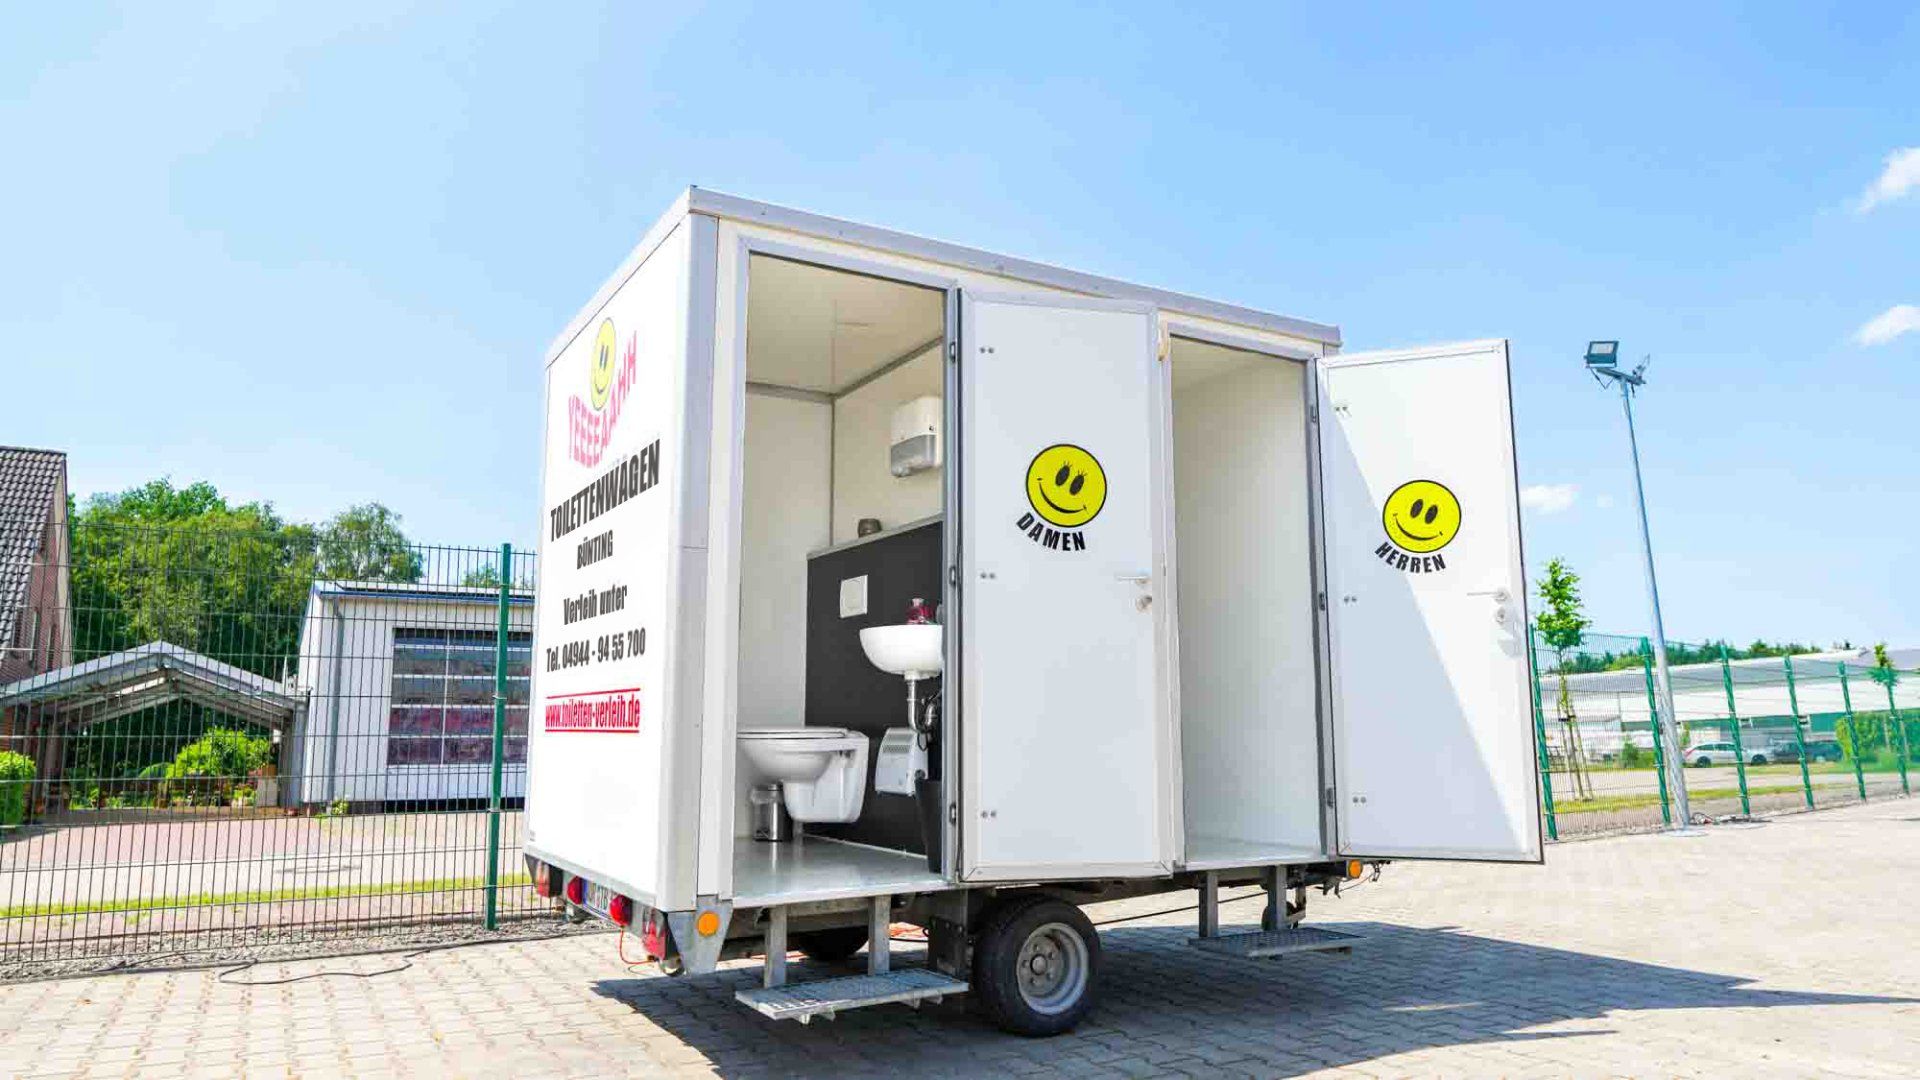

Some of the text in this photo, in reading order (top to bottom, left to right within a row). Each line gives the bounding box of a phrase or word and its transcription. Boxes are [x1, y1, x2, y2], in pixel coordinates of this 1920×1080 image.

[550, 438, 660, 542] TOILETTENWAGEN
[577, 529, 613, 570] BÜNTING
[1016, 512, 1086, 551] DAMEN
[1375, 541, 1446, 573] HERREN
[563, 583, 628, 625] Verleih unter
[546, 645, 561, 673] Tel.
[562, 638, 590, 670] 04944
[597, 633, 610, 664] 94
[611, 632, 624, 662] 55
[627, 626, 646, 658] 700
[545, 693, 641, 729] www.toiletten-verleih.de
